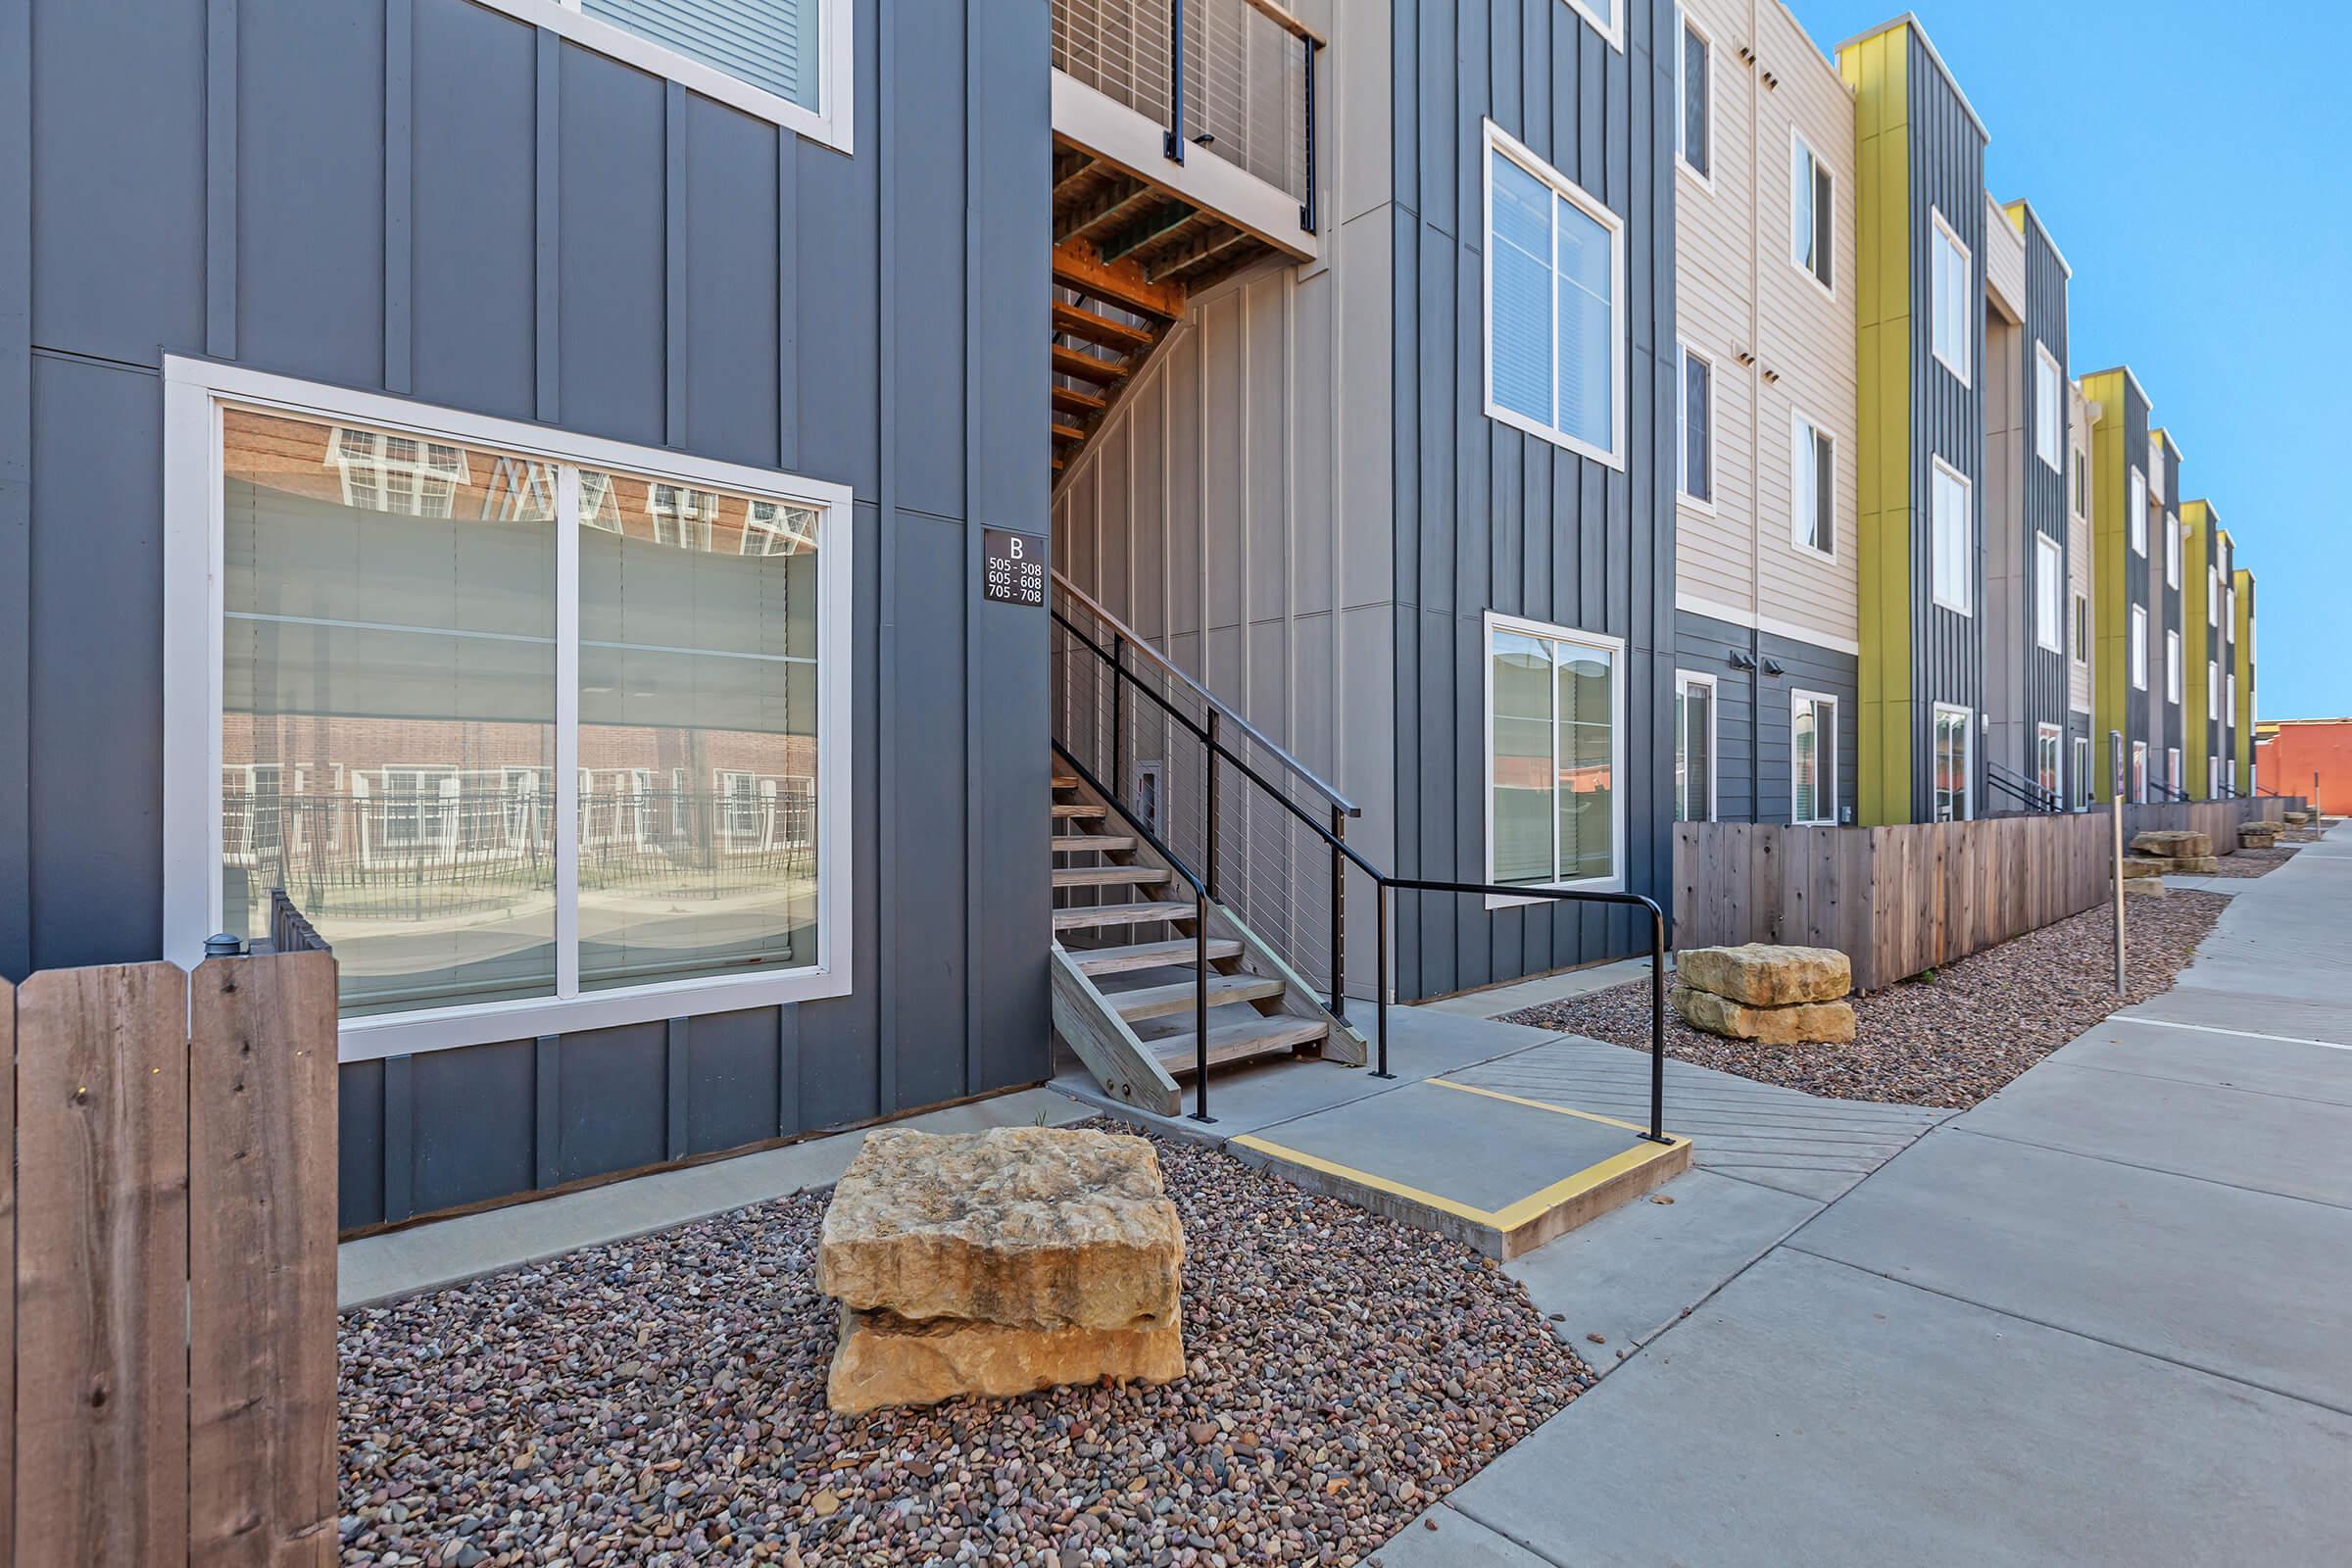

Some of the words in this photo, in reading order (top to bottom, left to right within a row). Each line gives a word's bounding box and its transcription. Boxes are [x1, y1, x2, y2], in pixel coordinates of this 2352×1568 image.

[1010, 537, 1023, 559] B
[990, 557, 1011, 571] 505
[1020, 562, 1042, 576] 508
[989, 570, 1010, 584] 605
[1020, 575, 1042, 589] 608
[989, 584, 1010, 598] 705
[1020, 588, 1042, 603] 708
